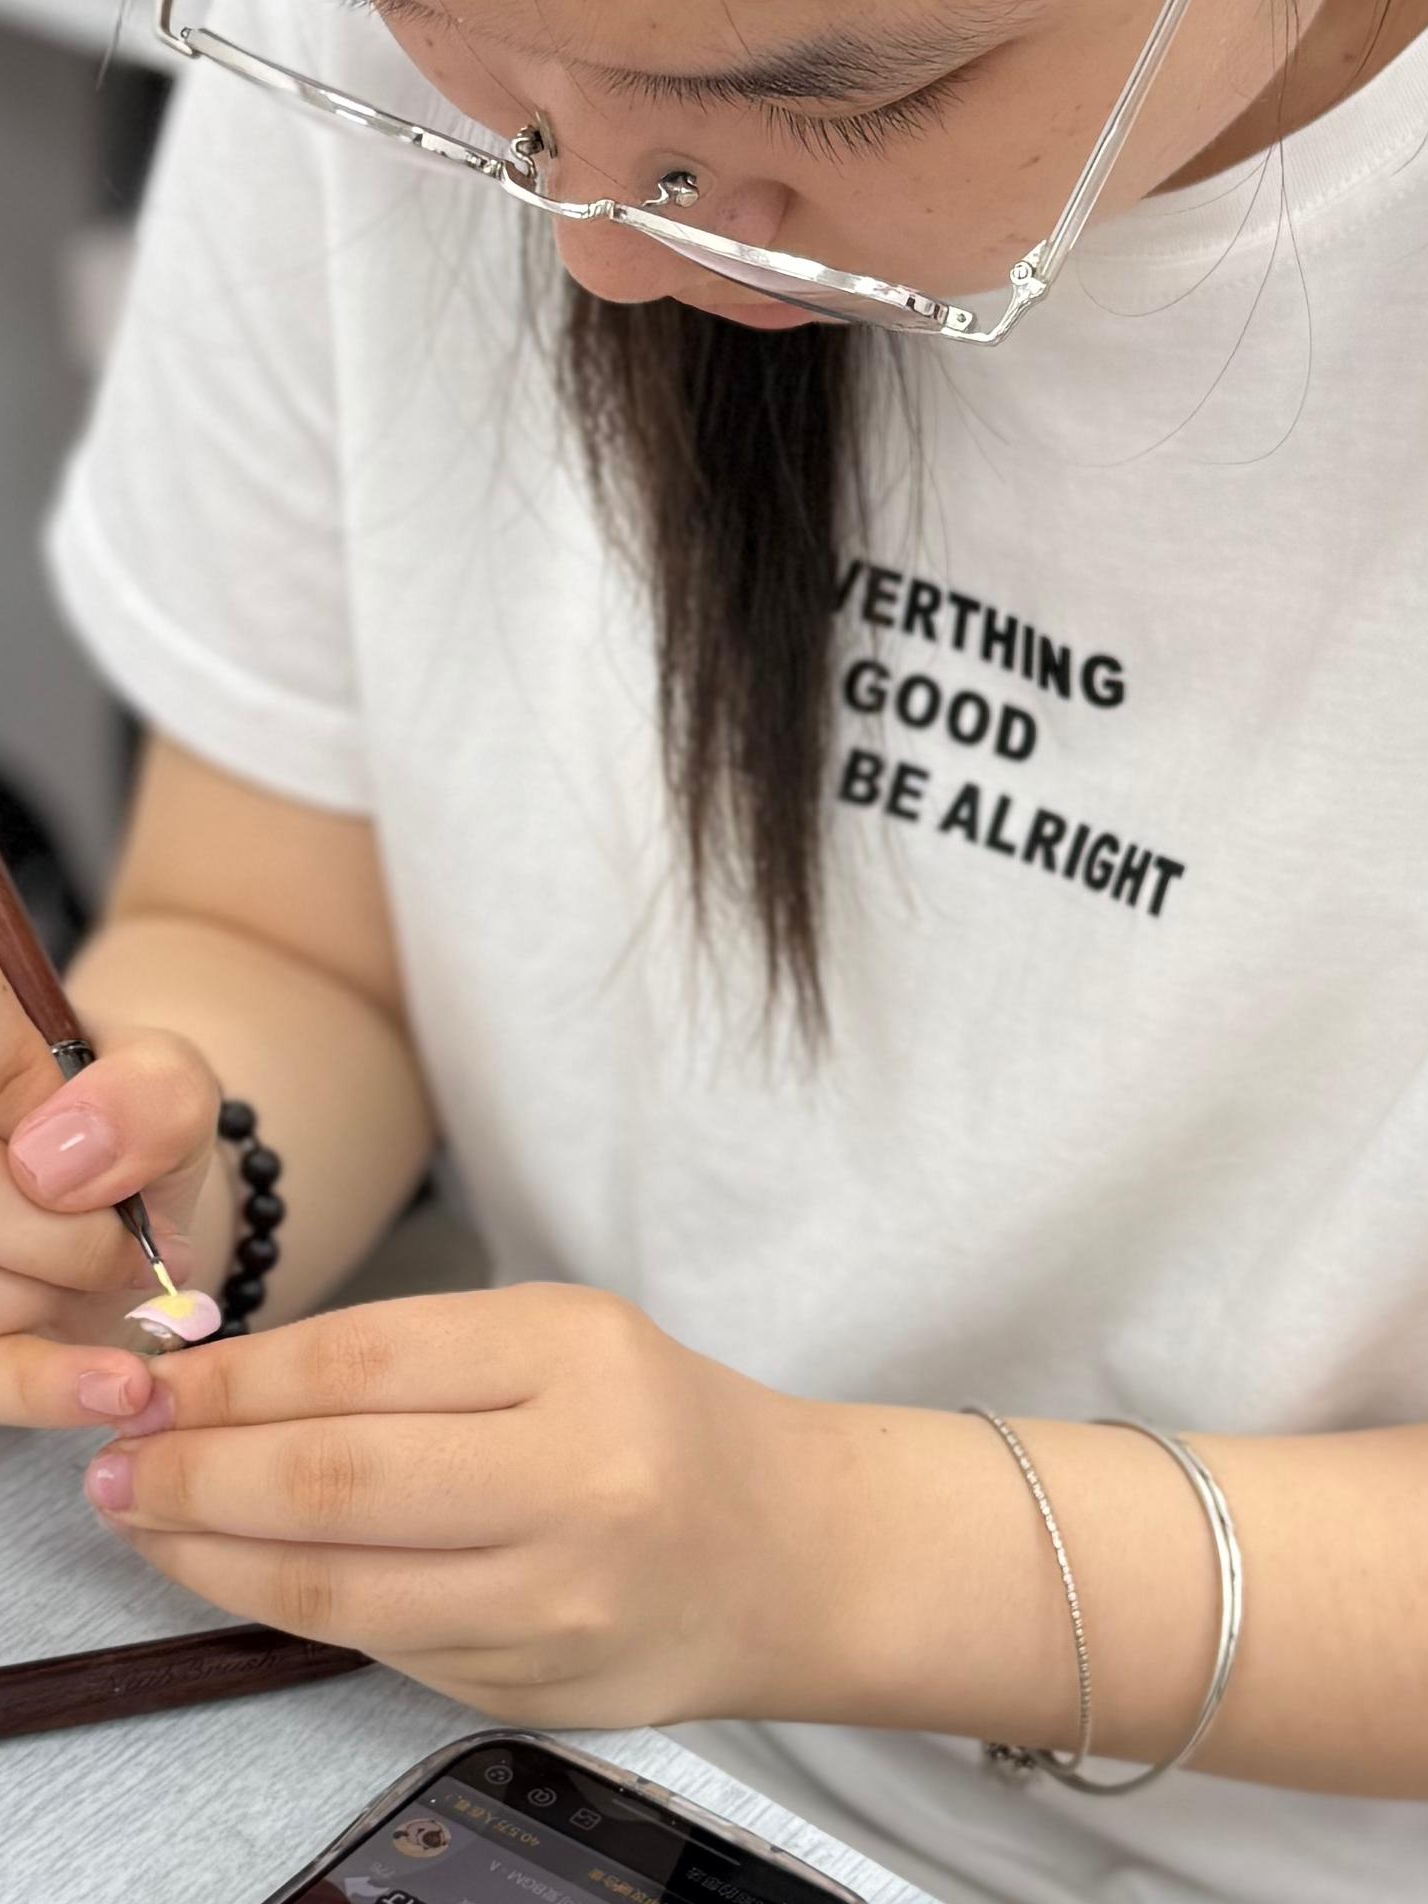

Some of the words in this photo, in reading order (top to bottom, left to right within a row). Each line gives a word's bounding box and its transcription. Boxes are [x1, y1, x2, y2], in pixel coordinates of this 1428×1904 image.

[834, 559, 1126, 709] VERTHING
[842, 659, 1038, 763] GOOD
[837, 748, 930, 822] BE
[939, 782, 1185, 918] ALRIGHT
